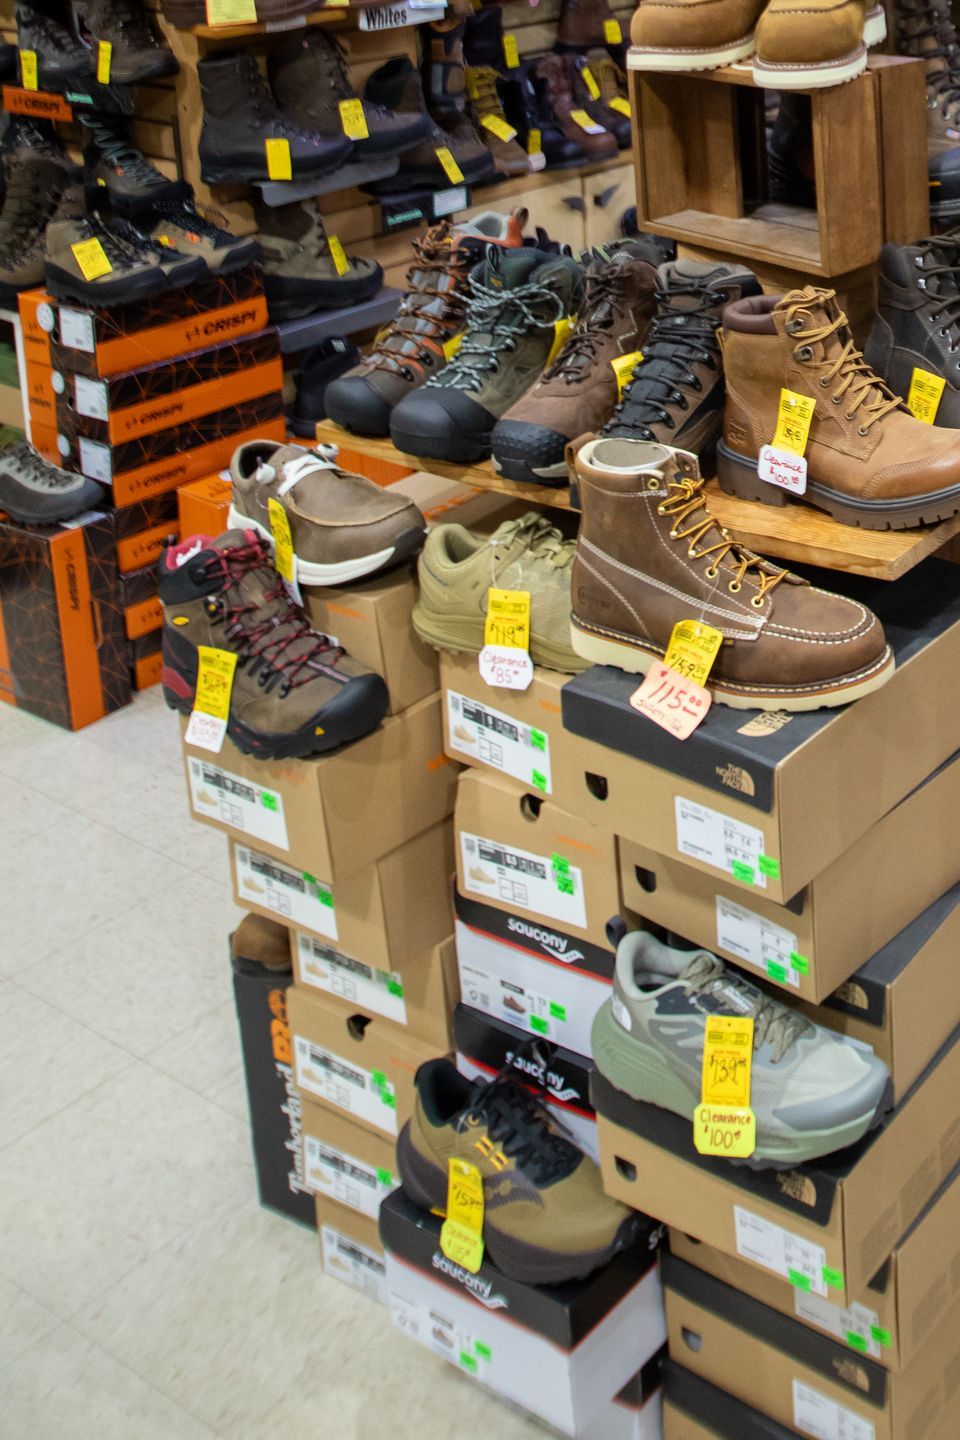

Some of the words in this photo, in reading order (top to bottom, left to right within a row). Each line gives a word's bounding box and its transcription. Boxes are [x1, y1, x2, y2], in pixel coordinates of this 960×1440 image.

[365, 5, 408, 31] Whites
[506, 917, 568, 952] saucony
[700, 1108, 752, 1127] Clearance
